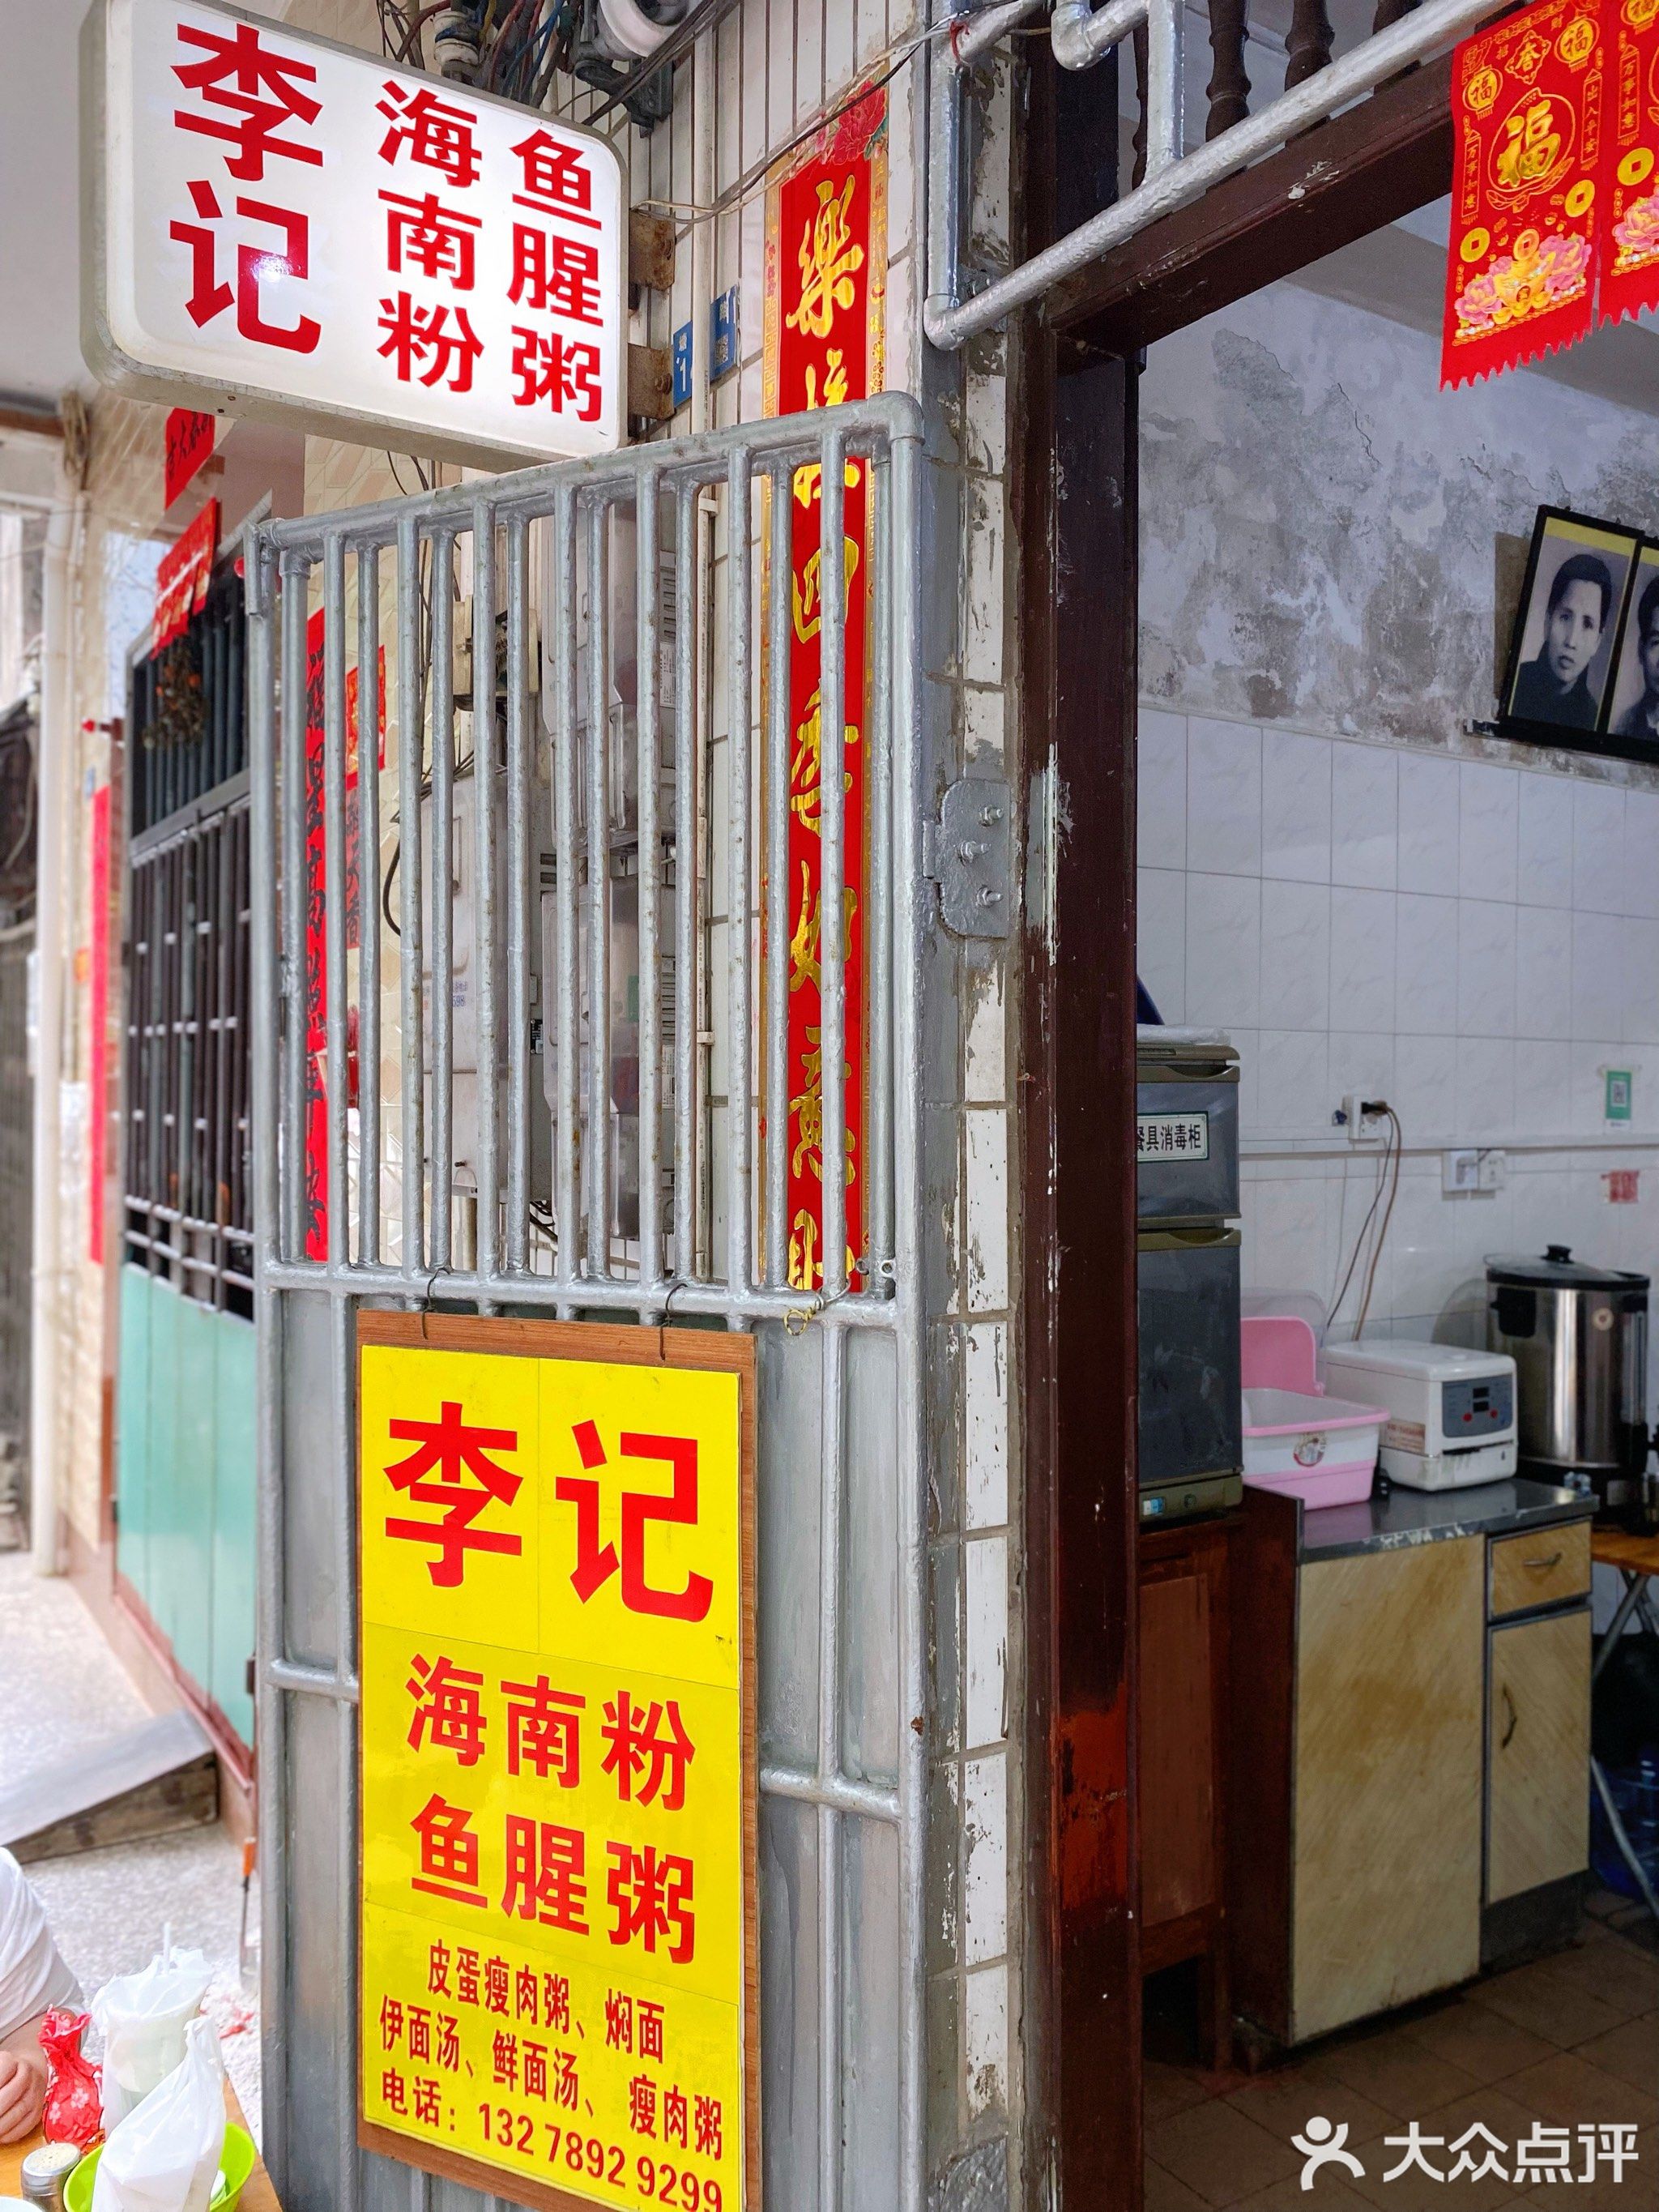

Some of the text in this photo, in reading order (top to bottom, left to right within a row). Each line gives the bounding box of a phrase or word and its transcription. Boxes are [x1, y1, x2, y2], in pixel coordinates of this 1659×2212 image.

[169, 23, 323, 354] 李记
[375, 79, 484, 393] 海南粉
[1497, 100, 1561, 187] 福
[507, 129, 604, 422] 鱼腥粥
[382, 1401, 714, 1623] 李记
[405, 1653, 696, 1812] 海南粉
[410, 1793, 695, 1964] 鱼腥粥
